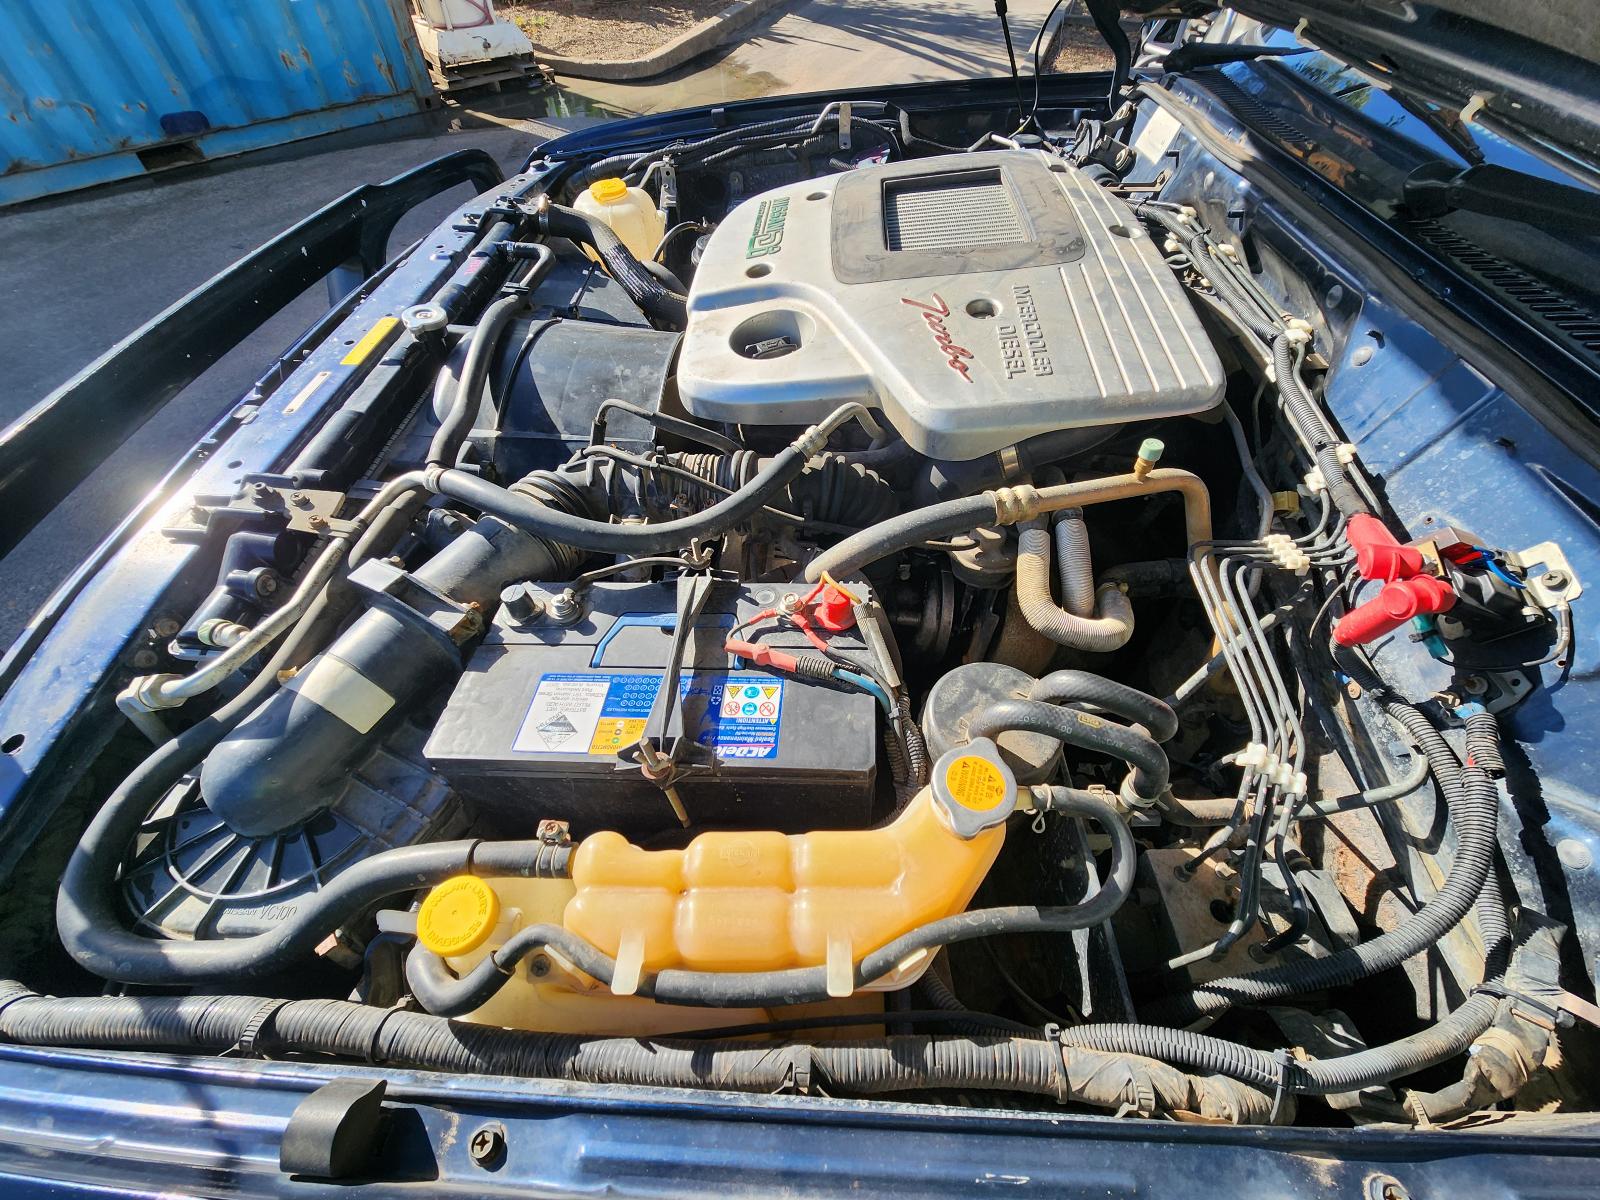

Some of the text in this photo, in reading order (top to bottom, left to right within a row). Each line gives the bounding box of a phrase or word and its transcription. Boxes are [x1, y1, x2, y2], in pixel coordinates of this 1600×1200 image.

[900, 292, 975, 384] Turbo
[995, 323, 1027, 380] DIESEL
[1012, 284, 1054, 377] INTERCOOLER
[711, 746, 772, 757] ACDelc
[716, 735, 755, 743] Maintenance
